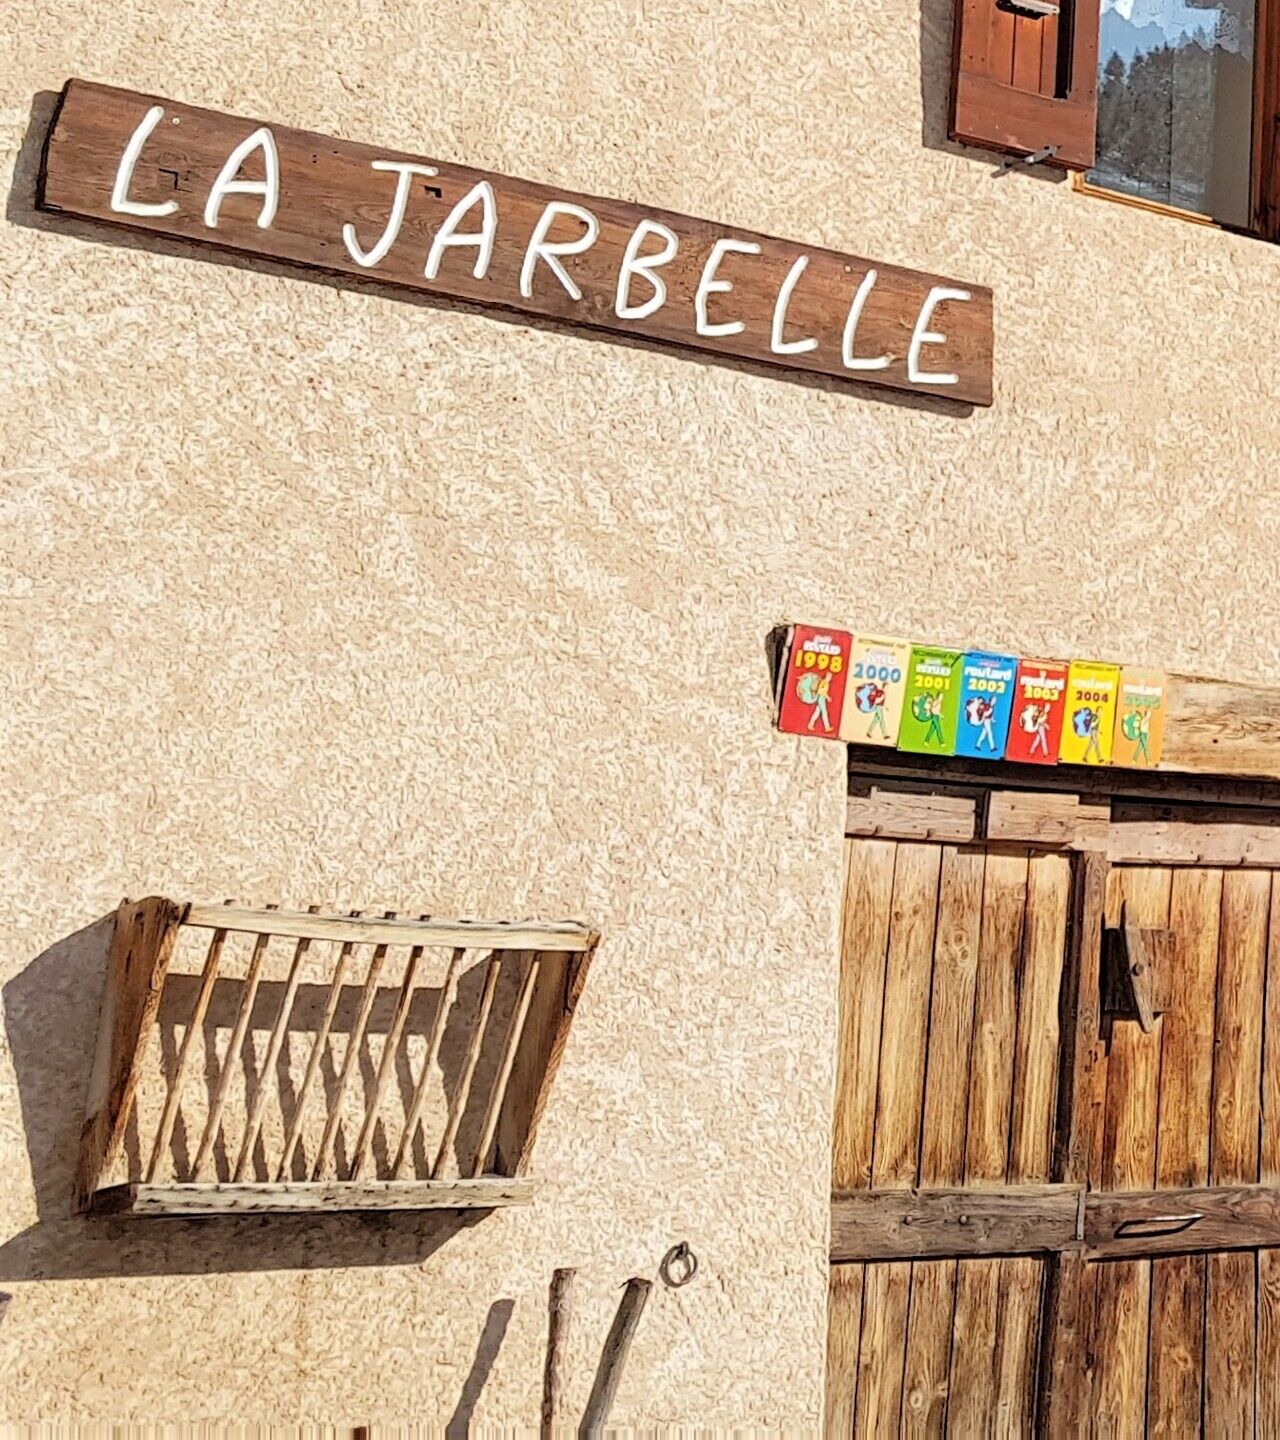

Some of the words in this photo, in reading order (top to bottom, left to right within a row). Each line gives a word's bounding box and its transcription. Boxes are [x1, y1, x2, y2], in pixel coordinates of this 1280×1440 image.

[110, 105, 277, 229] LA
[341, 160, 970, 385] JARBELLE
[795, 649, 843, 674] 1998
[853, 662, 901, 683] 2000
[915, 674, 950, 690] 2001
[967, 677, 1007, 694] 2002
[1024, 685, 1059, 701] 2003
[1076, 690, 1109, 703] 2004
